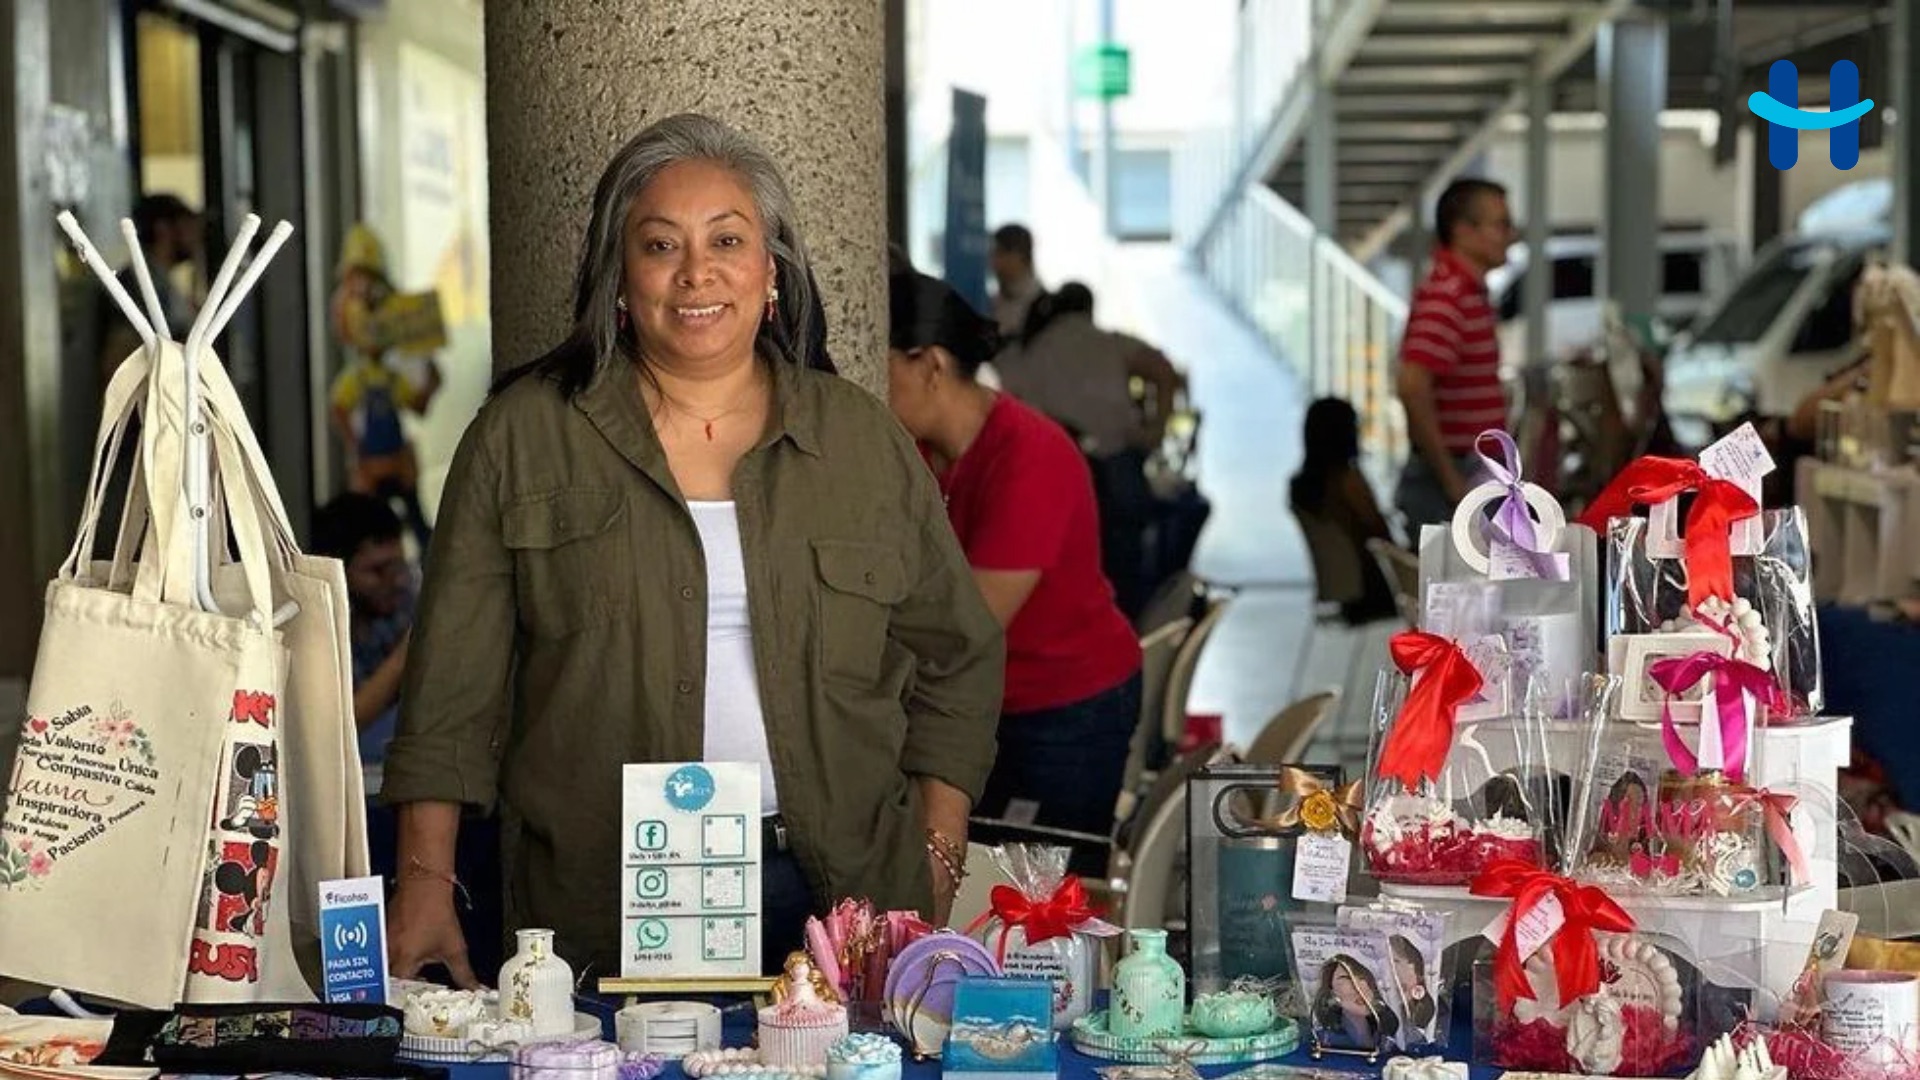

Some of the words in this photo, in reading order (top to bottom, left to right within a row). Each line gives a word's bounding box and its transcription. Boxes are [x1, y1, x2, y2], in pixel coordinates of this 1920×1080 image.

[51, 705, 92, 731] Sabia
[37, 756, 121, 785] Compasiva
[16, 793, 103, 823] Inspiradora
[352, 957, 369, 967] SIN
[328, 968, 375, 982] CONTACTO
[331, 992, 352, 1002] VISA
